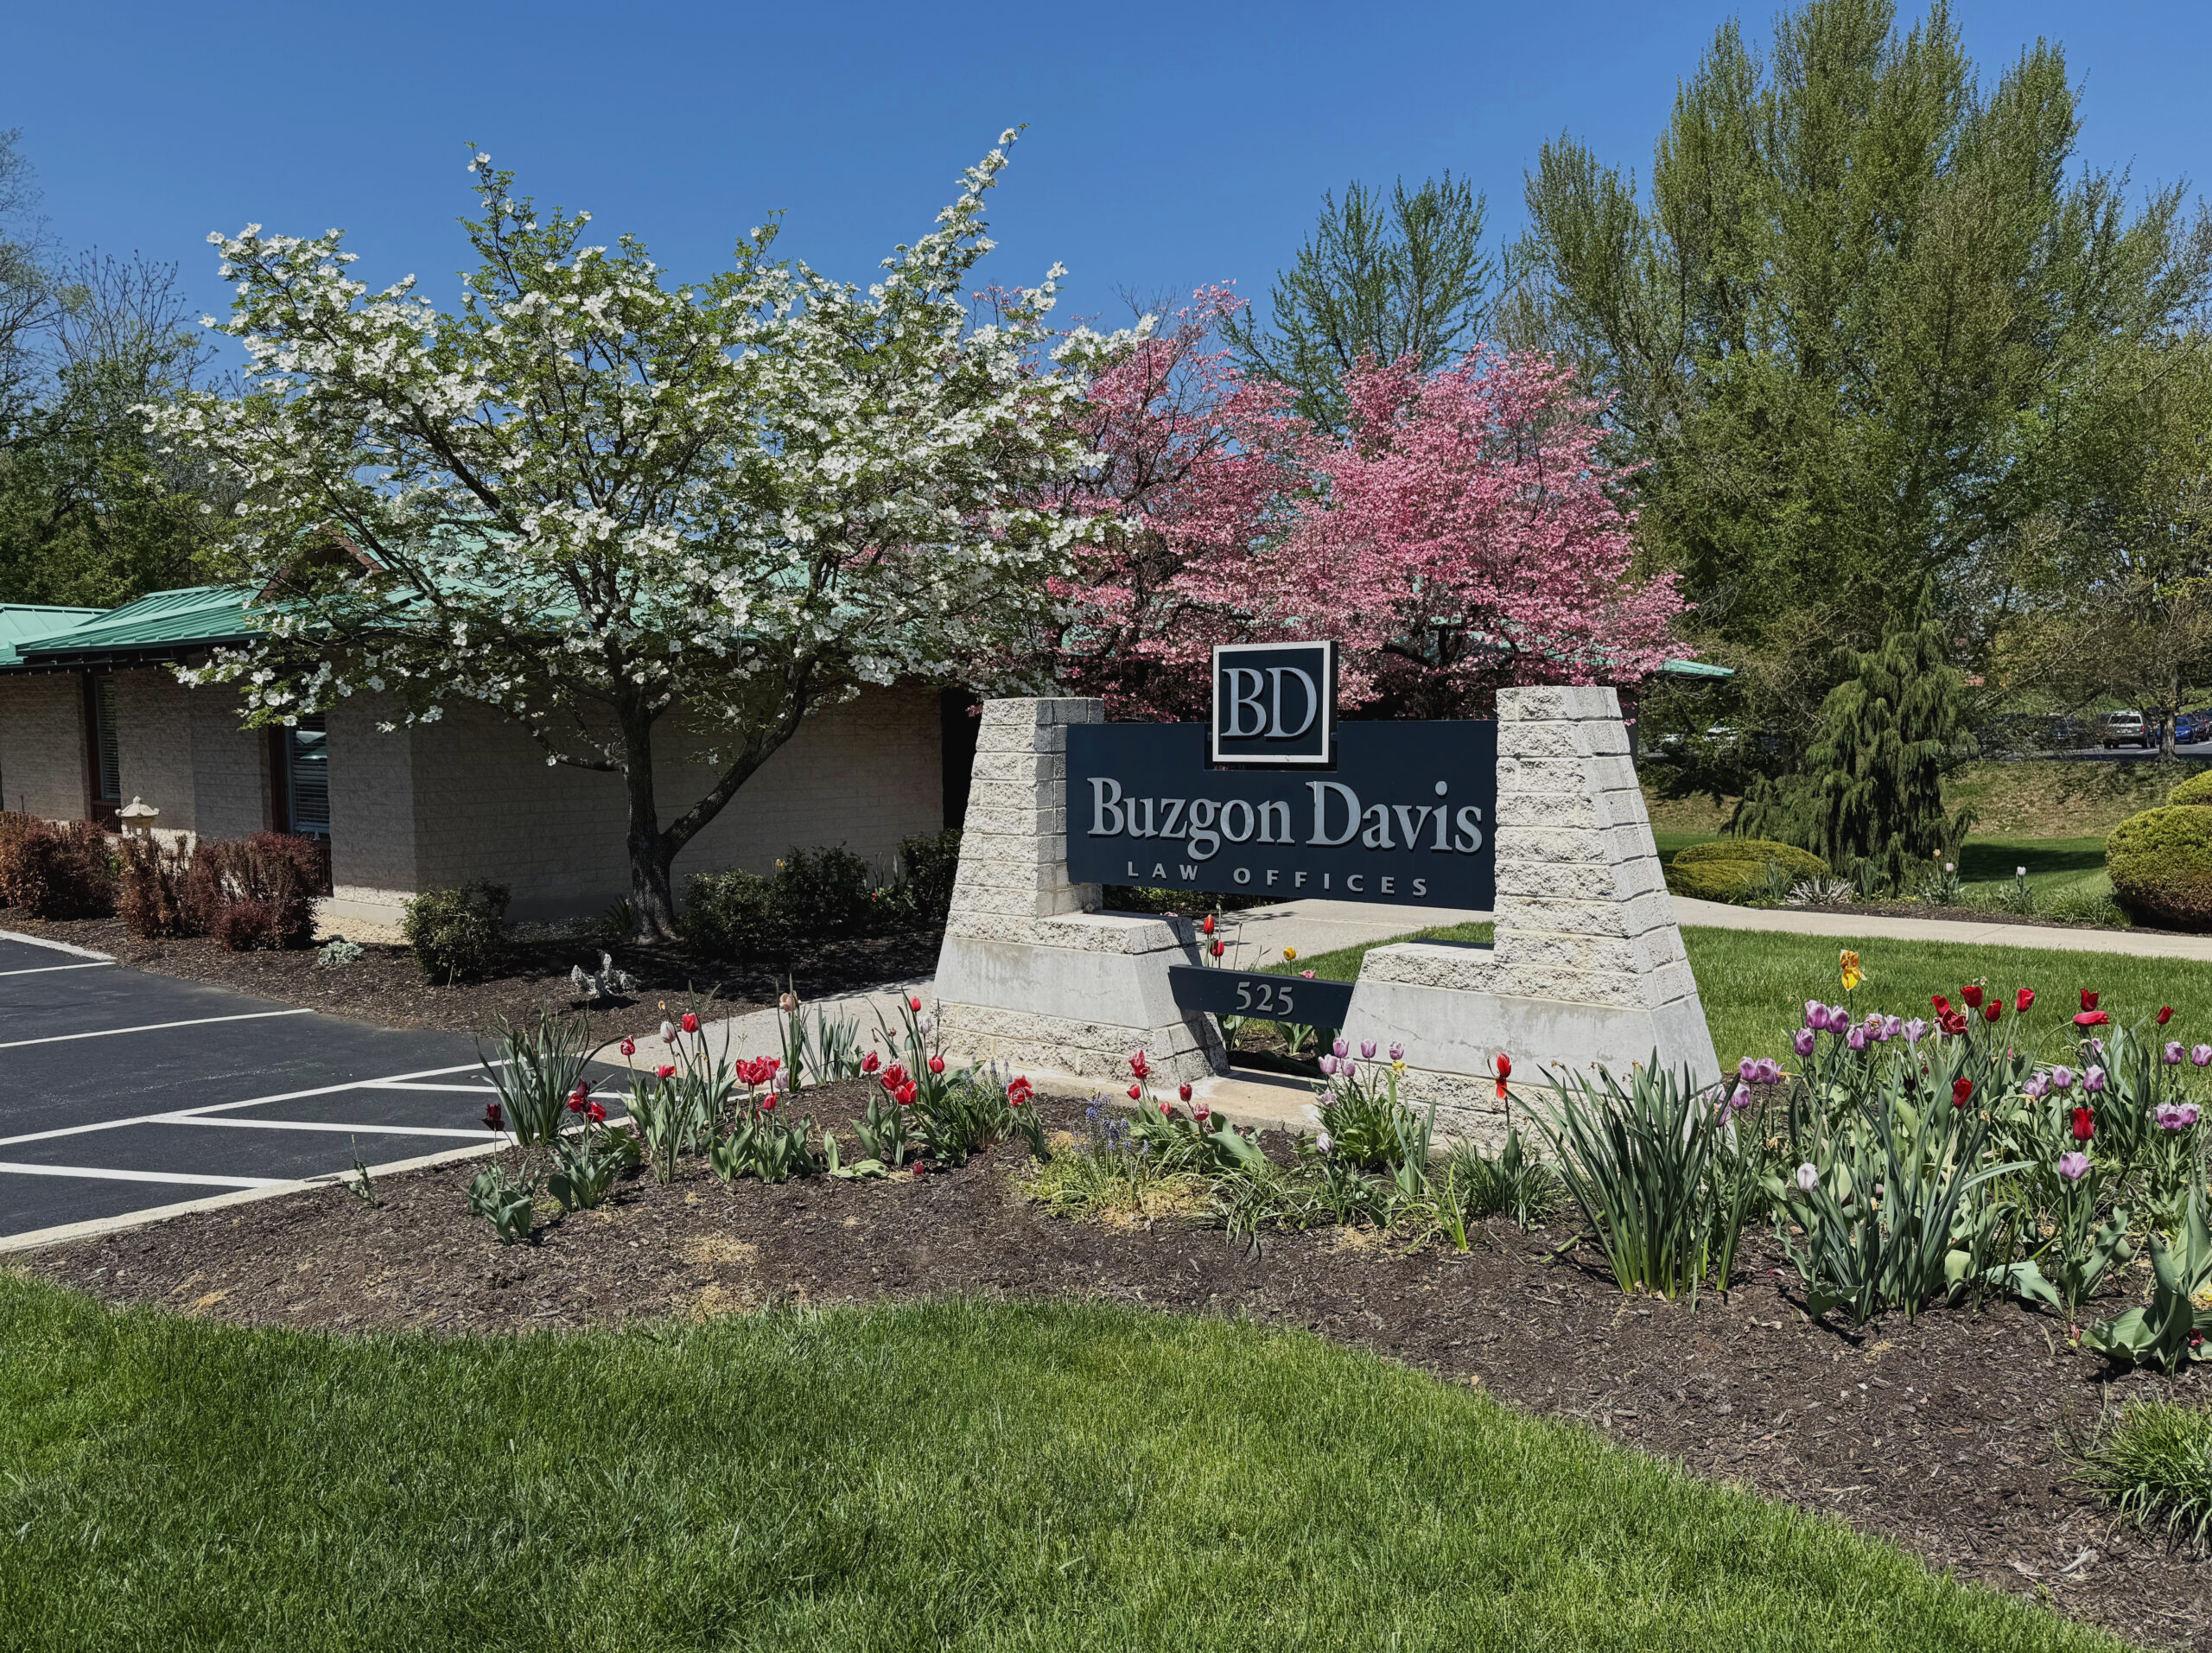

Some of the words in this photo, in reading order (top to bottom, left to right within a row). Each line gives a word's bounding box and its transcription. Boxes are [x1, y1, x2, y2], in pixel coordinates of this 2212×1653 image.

[1220, 667, 1318, 738] BD
[1087, 777, 1294, 861] Buzgon
[1306, 780, 1483, 854] Davis
[1128, 861, 1198, 881] LAW
[1234, 868, 1427, 897] OFFICES
[1236, 982, 1294, 1015] 525
